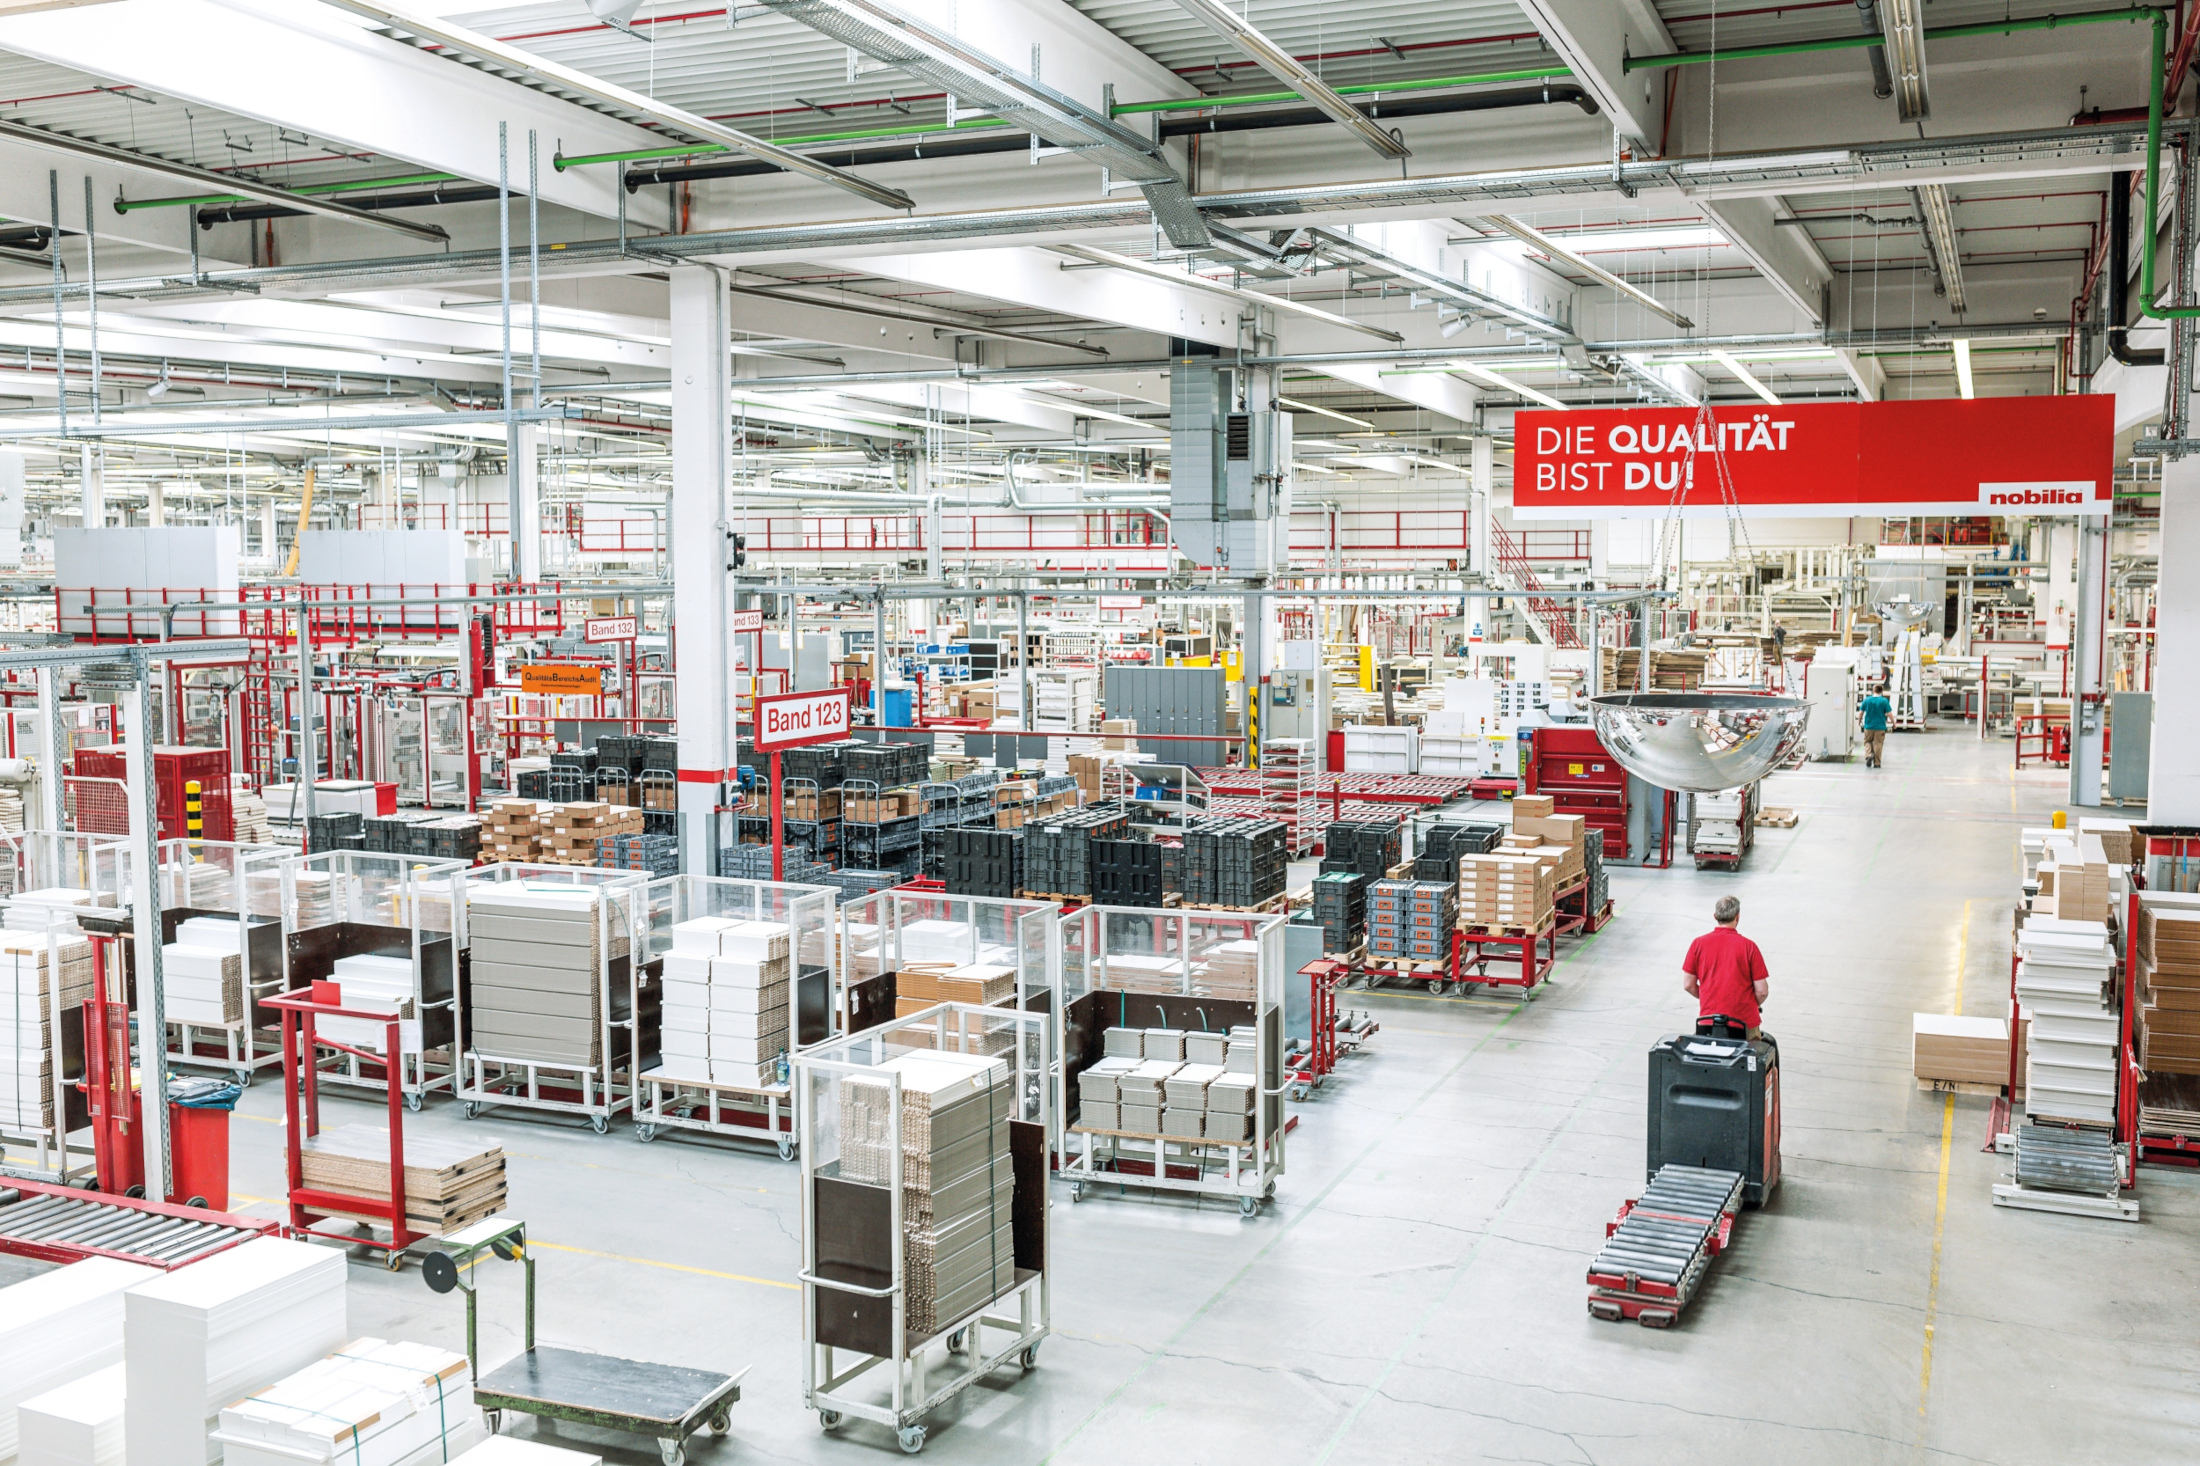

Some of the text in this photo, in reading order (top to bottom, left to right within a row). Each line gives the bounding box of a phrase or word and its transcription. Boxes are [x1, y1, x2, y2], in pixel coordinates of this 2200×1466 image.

[1537, 414, 1795, 455] DIE QUALITÄT
[1537, 460, 1694, 492] BIST DU!
[1990, 489, 2083, 505] nobilia
[591, 621, 632, 636] Band 132
[747, 614, 760, 625] 133
[768, 701, 842, 733] Band 123
